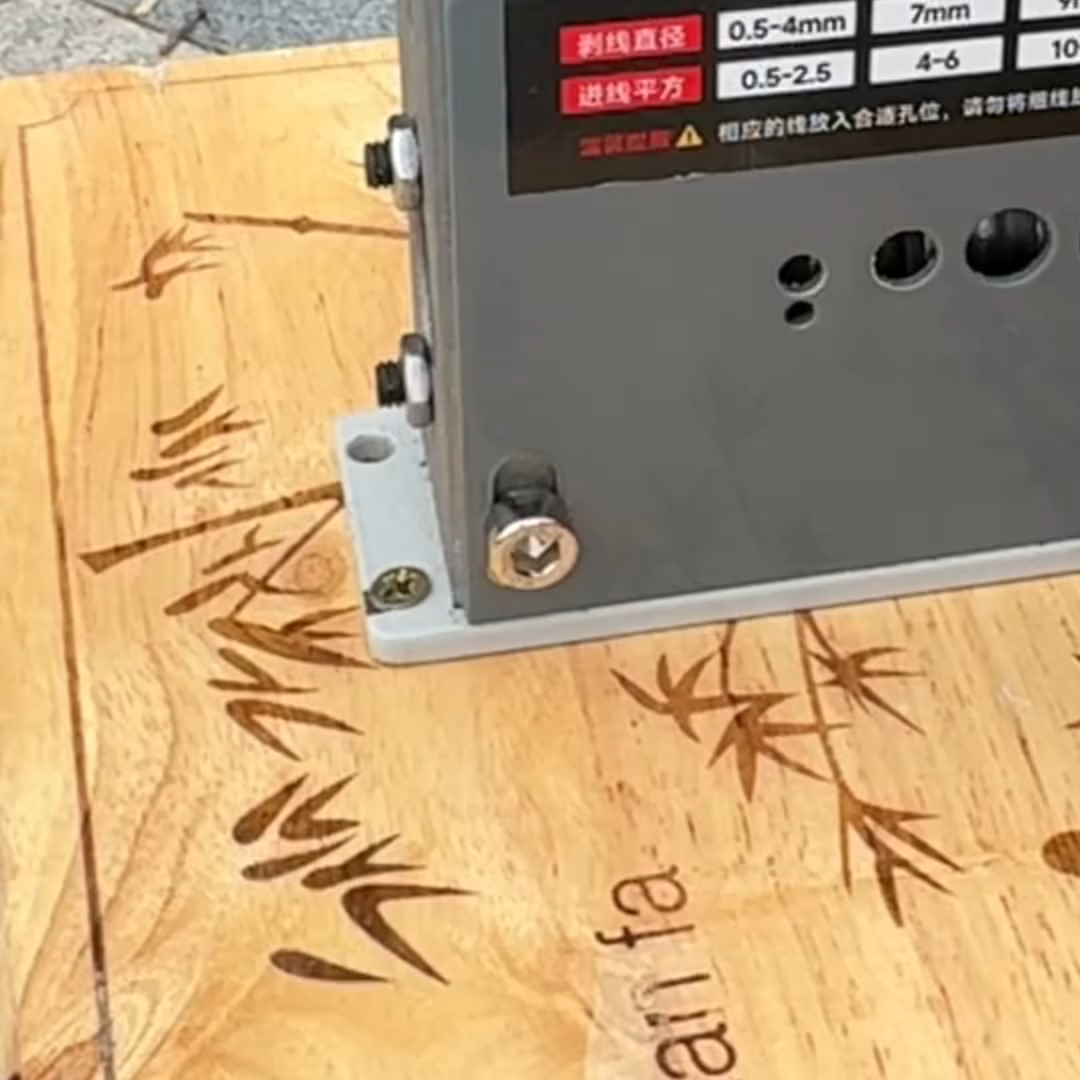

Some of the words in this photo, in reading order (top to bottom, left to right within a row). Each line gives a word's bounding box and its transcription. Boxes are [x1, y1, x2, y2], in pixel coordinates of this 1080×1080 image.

[910, 2, 971, 25] 7mm
[729, 14, 847, 41] 0.5-4mm
[577, 24, 686, 59] 剥线直径
[915, 50, 960, 73] 4-6
[742, 63, 832, 90] 0.5-2.5
[578, 75, 685, 108] 进线平方
[594, 864, 695, 949] fa
